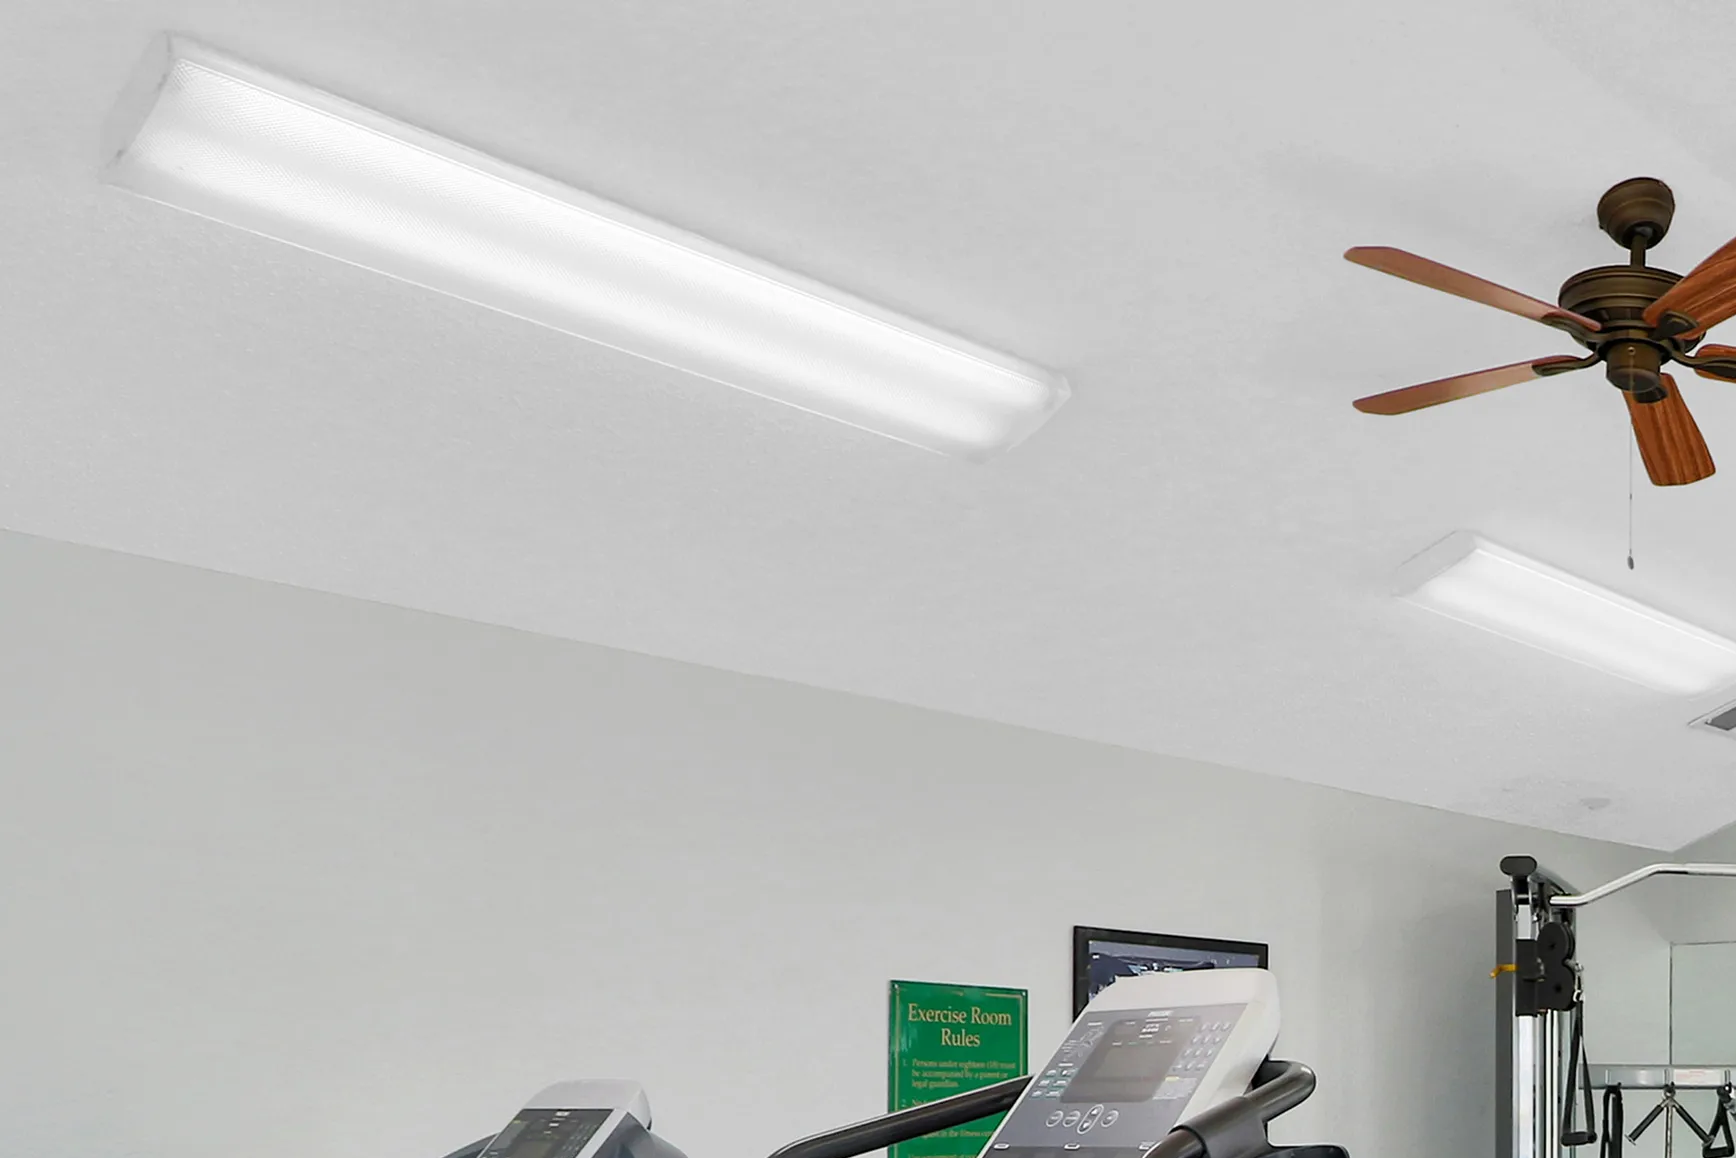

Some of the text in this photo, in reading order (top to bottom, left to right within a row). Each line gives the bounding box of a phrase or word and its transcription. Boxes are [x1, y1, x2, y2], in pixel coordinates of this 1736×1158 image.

[908, 1003, 1012, 1026] Exercise Room
[941, 1028, 981, 1048] Rules
